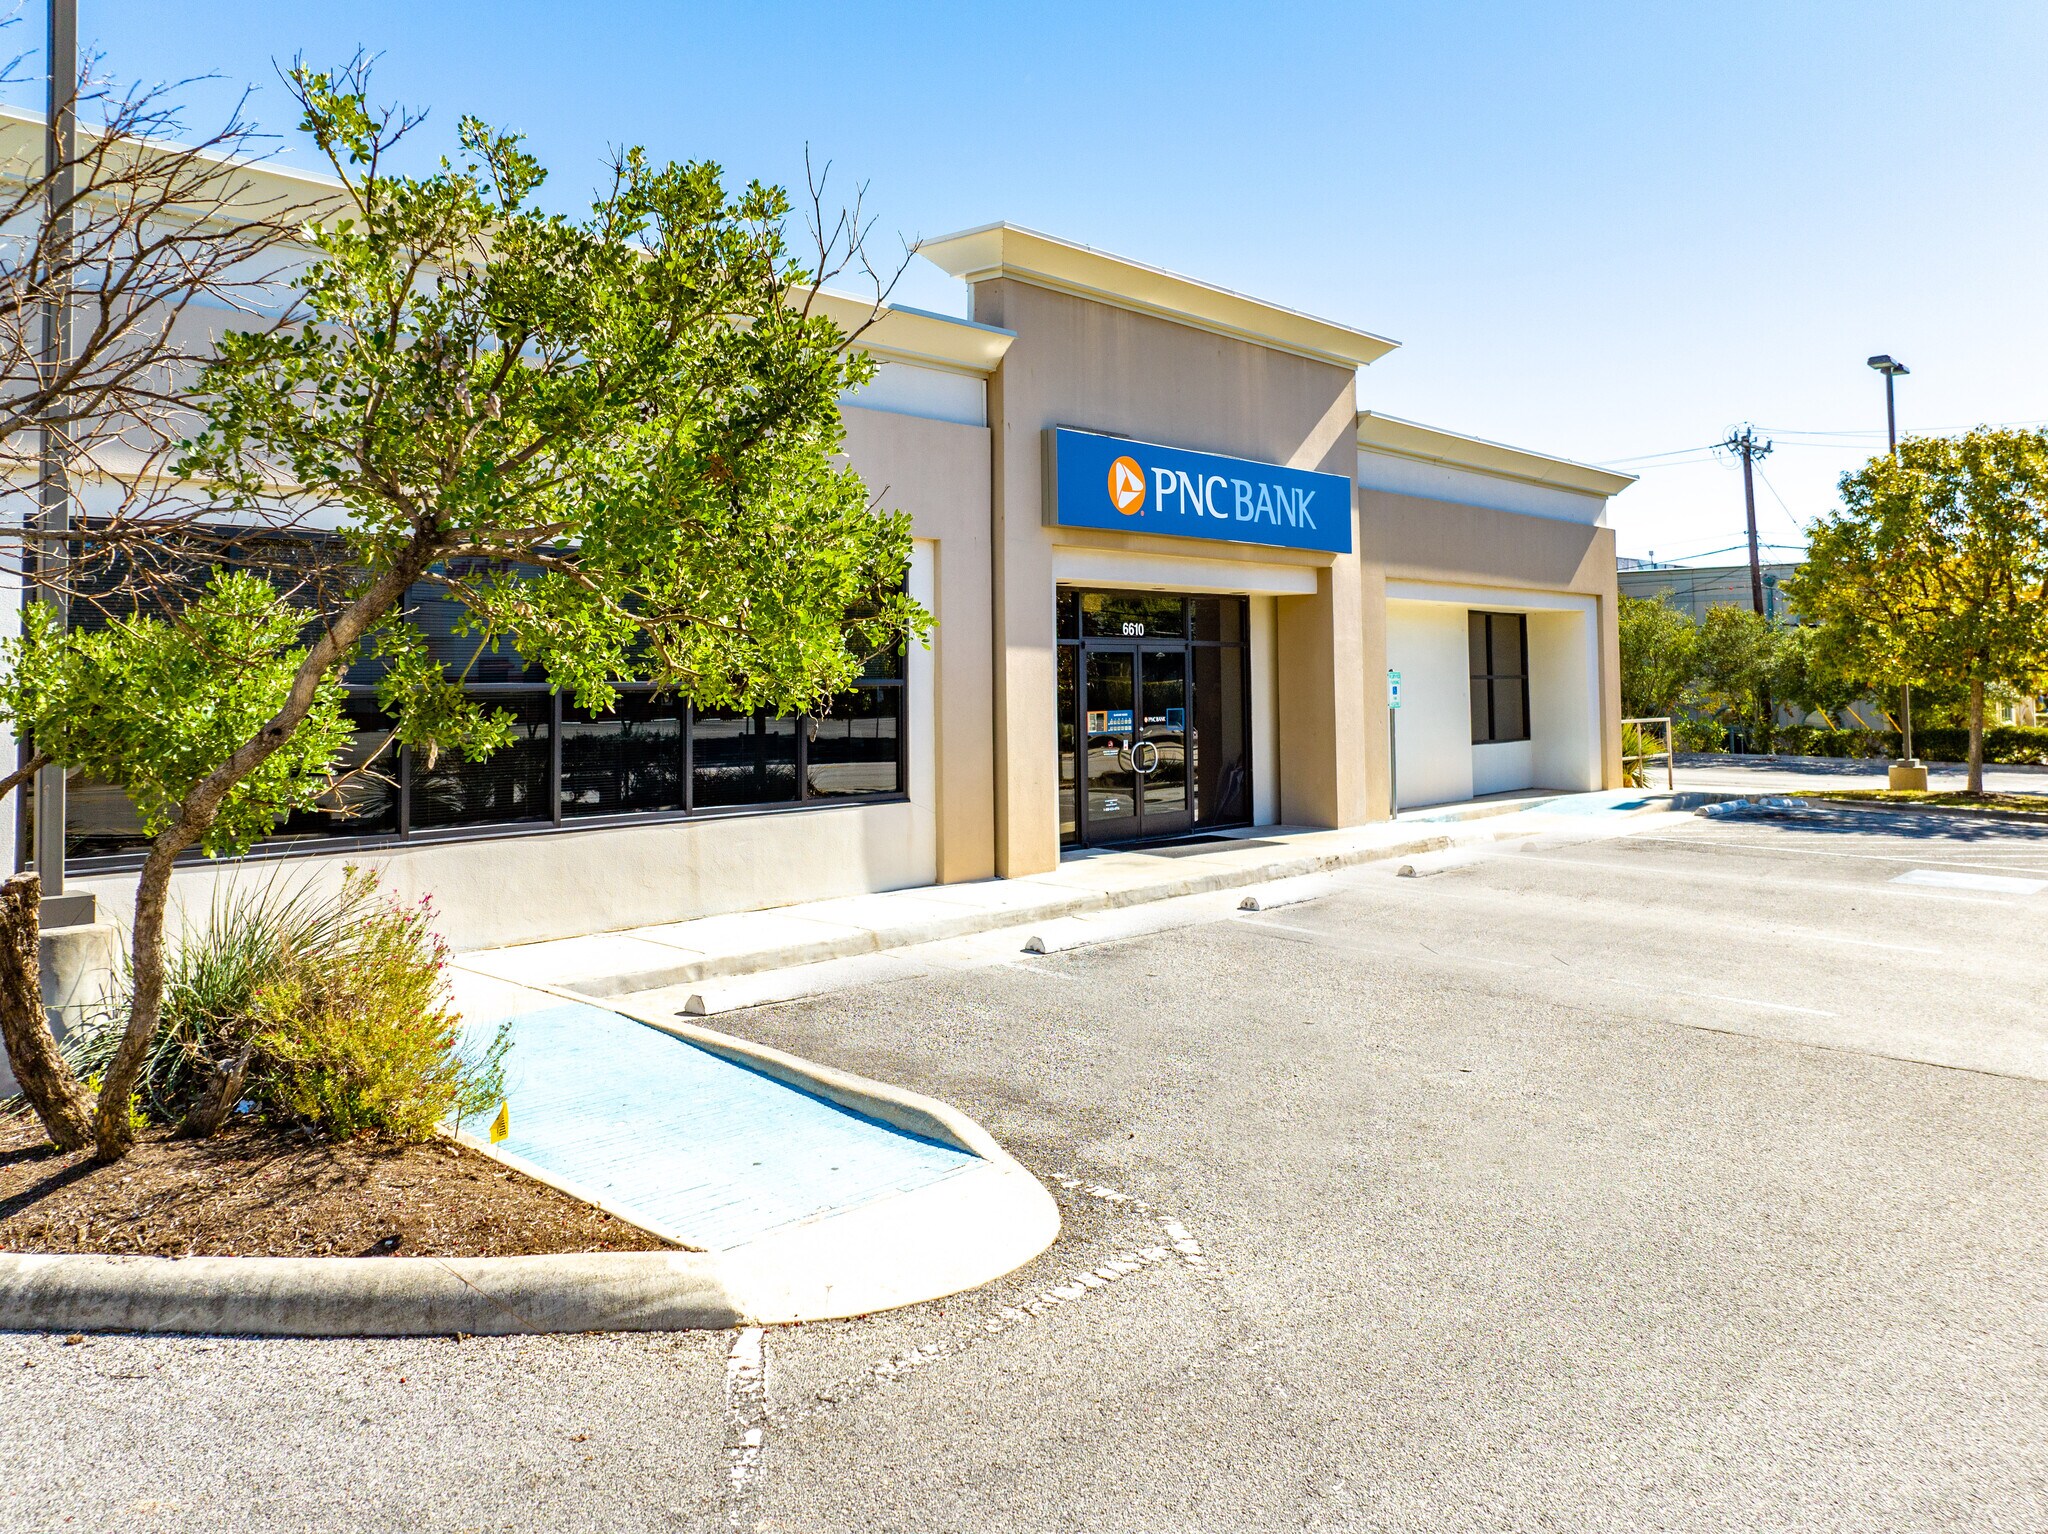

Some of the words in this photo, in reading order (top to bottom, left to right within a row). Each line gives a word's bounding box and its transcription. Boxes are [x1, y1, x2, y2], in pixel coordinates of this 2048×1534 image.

[1151, 467, 1229, 519] PNC
[1230, 478, 1317, 530] BANK
[1122, 622, 1144, 636] 6610
